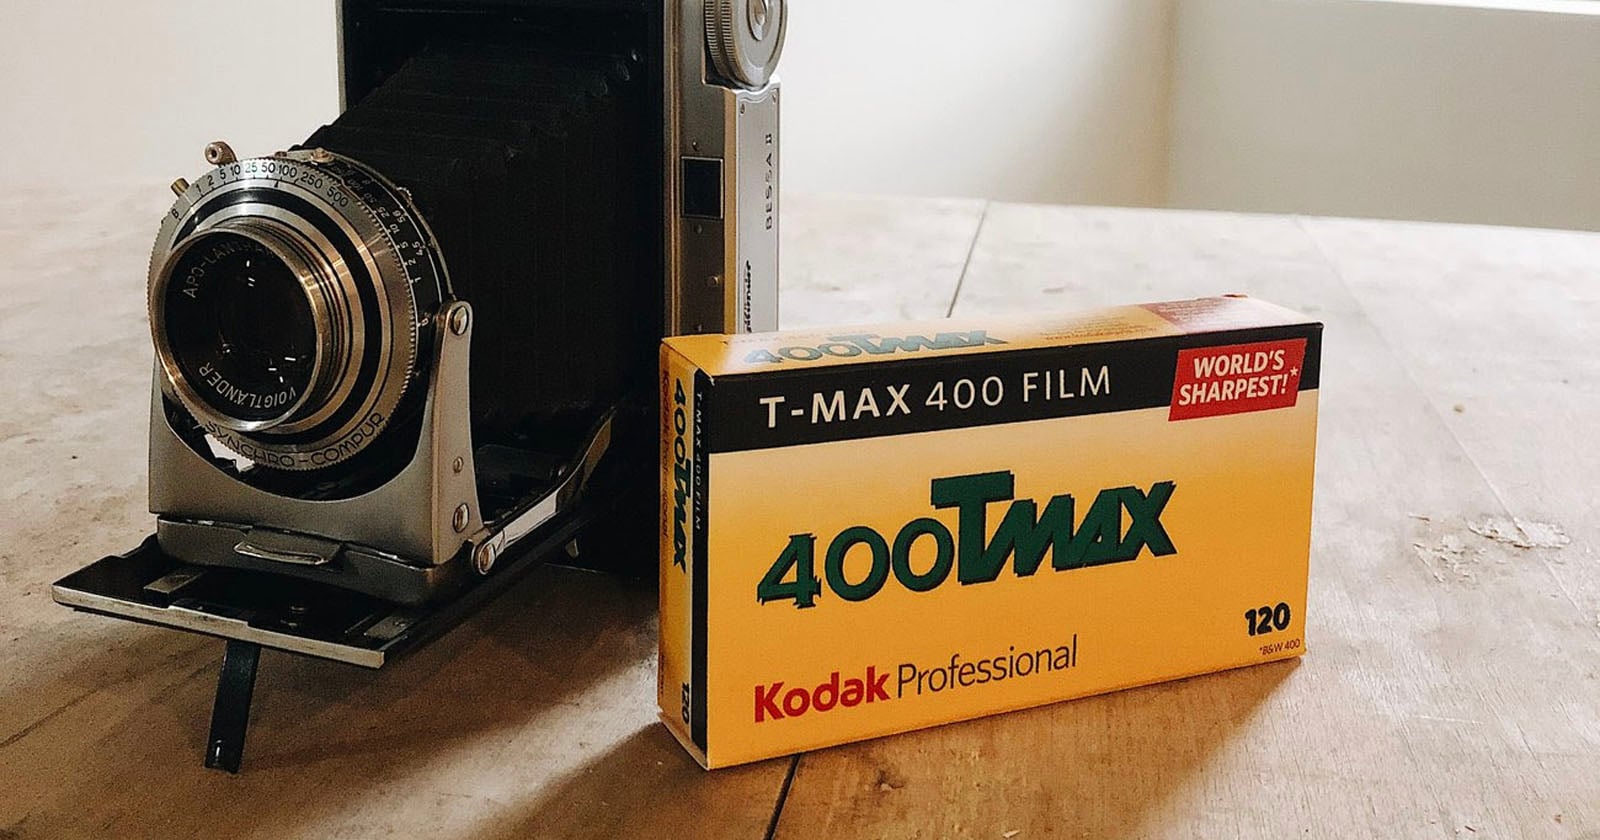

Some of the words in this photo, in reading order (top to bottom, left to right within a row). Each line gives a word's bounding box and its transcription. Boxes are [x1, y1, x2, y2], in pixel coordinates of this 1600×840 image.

[207, 175, 215, 186] 2
[219, 169, 226, 180] 5
[230, 164, 242, 176] 10
[245, 164, 258, 174] 25
[261, 163, 276, 174] 50
[278, 164, 298, 178] 100
[300, 171, 323, 190] 250
[326, 187, 349, 208] 500
[1193, 350, 1286, 379] WORLD'S
[760, 383, 911, 429] T-MAX
[925, 375, 1004, 412] 400
[1023, 365, 1111, 403] FILM
[1244, 602, 1291, 637] 120
[1284, 638, 1301, 650] 400
[754, 665, 891, 722] Kodak
[897, 634, 1078, 699] Professional
